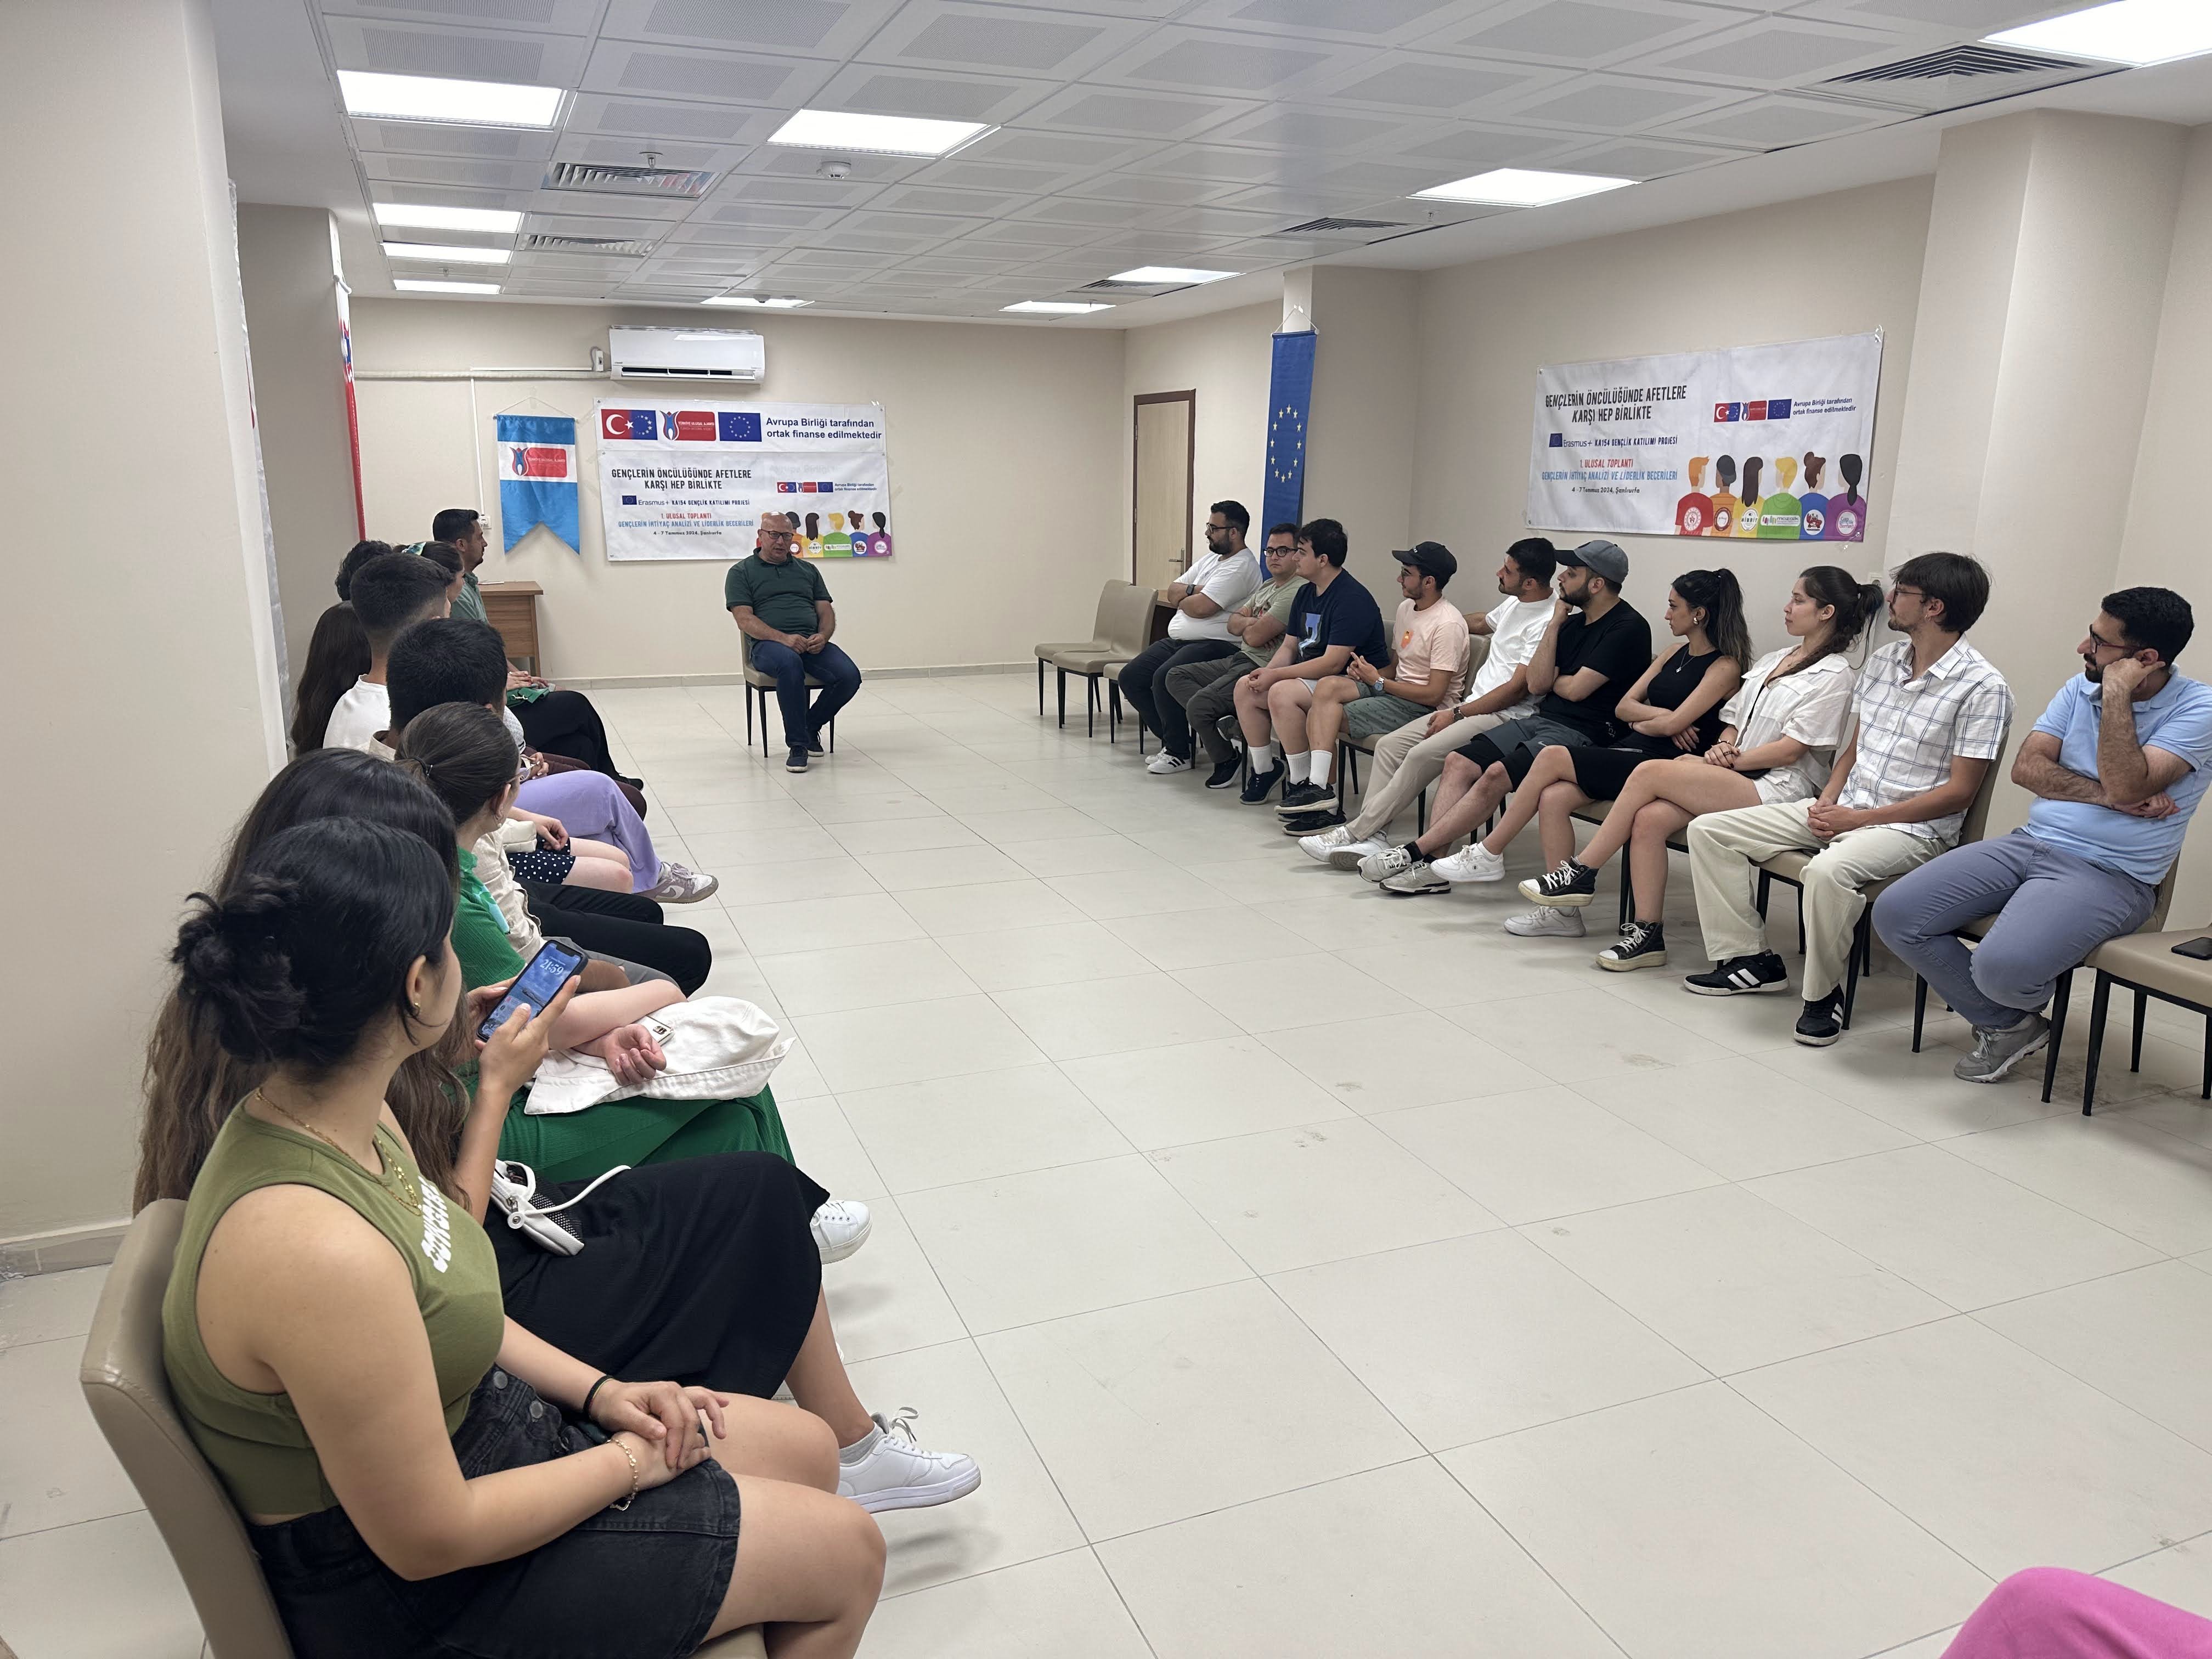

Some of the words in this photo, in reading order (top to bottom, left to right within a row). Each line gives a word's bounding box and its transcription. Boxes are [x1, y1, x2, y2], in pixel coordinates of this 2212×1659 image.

[1545, 390, 1584, 410] GENÇLERİN
[1586, 386, 1644, 405] ÖNCÜLÜĞÜNDE
[1645, 385, 1687, 402] AFETLERE
[1571, 409, 1595, 425] KARŞI
[1598, 408, 1613, 422] HEP
[1615, 403, 1652, 421] BİRLİKTE
[766, 417, 799, 427] Avrupa
[801, 417, 827, 428] Birliği
[830, 418, 874, 428] tarafından
[766, 430, 791, 438] ortak
[792, 430, 825, 439] finanse
[827, 430, 882, 439] edilmektedir
[1594, 438, 1610, 447] KA154
[1611, 437, 1632, 448] GENÇLİK
[1633, 437, 1656, 446] KATILIMI
[1658, 435, 1678, 445] PROJESİ
[1584, 459, 1606, 468] ULUSAL
[1607, 458, 1634, 468] TOPLANTI
[612, 467, 655, 480] GENÇLERİN
[658, 467, 713, 478] ÖNCÜLÜĞÜNDE
[715, 469, 752, 478] AFETLERE
[1542, 470, 1568, 482] GENÇLERİN
[1568, 470, 1587, 482] İHTİYAÇ
[1588, 470, 1609, 481] ANALİZİ
[1611, 471, 1618, 480] VE
[1620, 470, 1645, 481] LİDERLİK
[1646, 470, 1678, 481] BECERİLERİ
[644, 480, 668, 491] KARŞI
[671, 481, 685, 489] HEP
[687, 478, 723, 489] BİRLİKTE
[539, 959, 564, 975] 21:59
